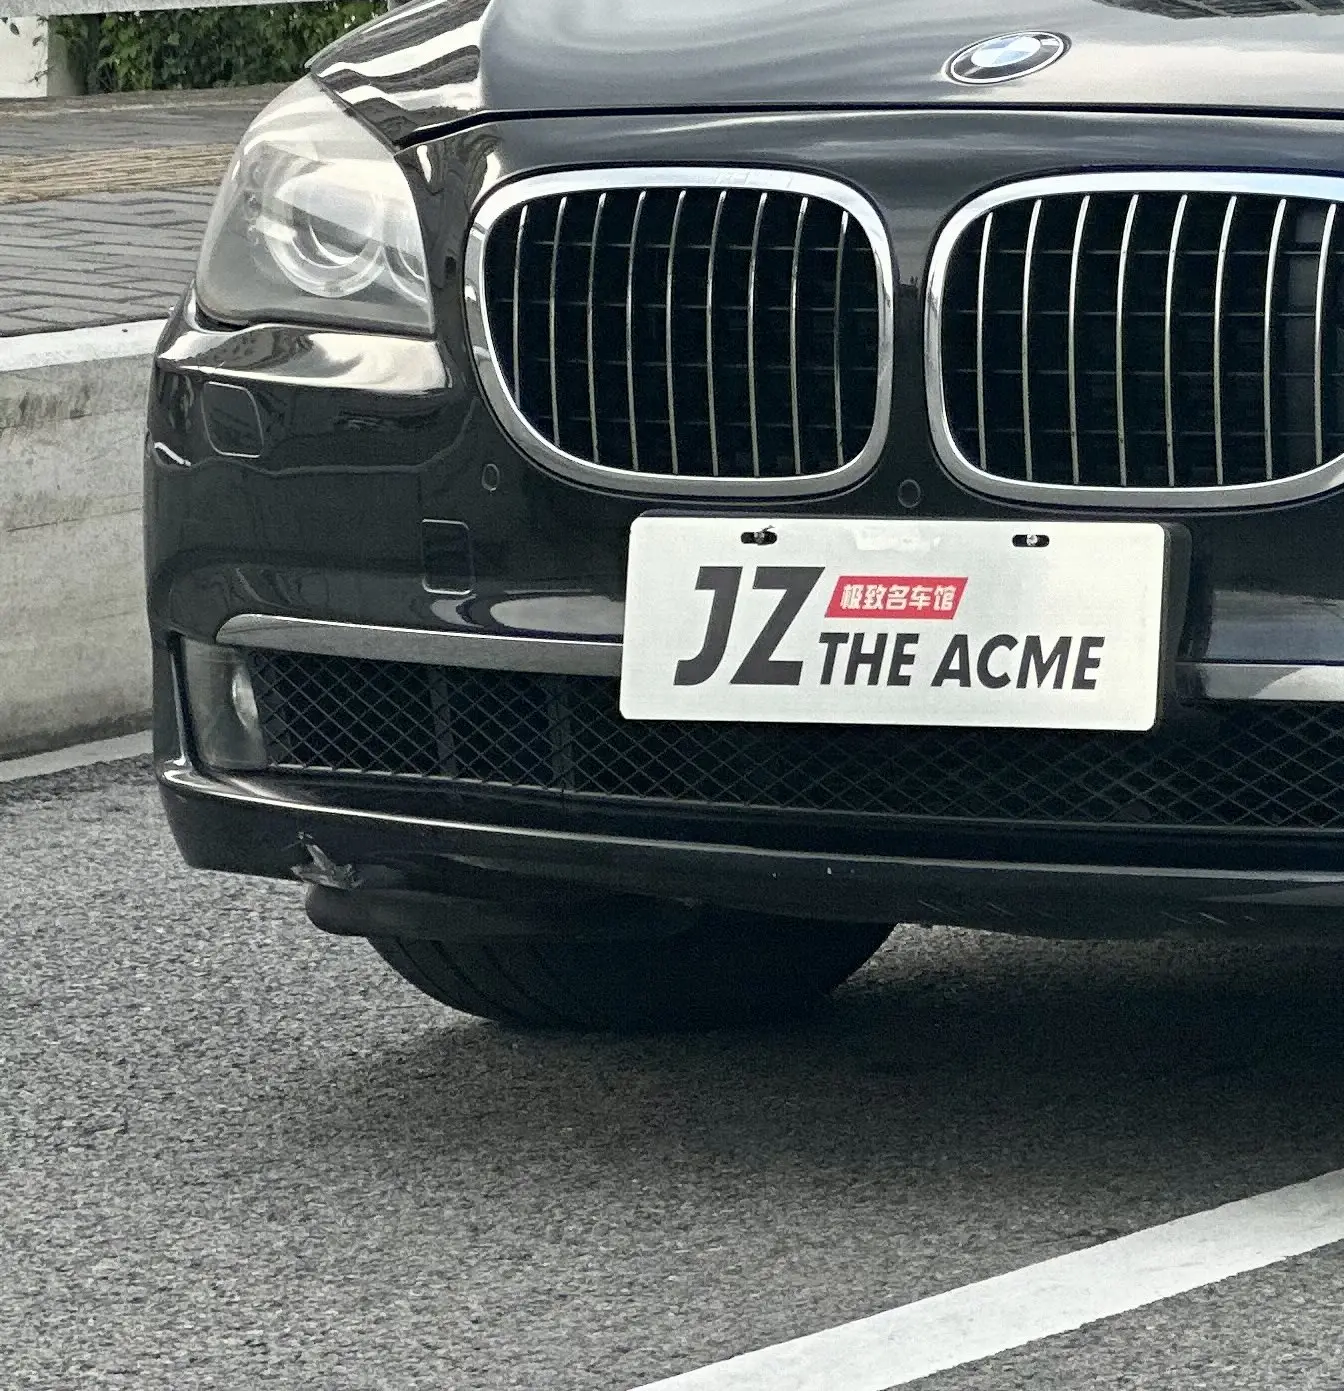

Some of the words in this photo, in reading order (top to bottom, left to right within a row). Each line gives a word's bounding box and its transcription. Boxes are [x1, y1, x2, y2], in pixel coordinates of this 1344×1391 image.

[673, 565, 826, 686] JZ
[840, 583, 957, 612] 极致名车馆
[818, 631, 920, 687] THE
[931, 633, 1106, 691] ACME
